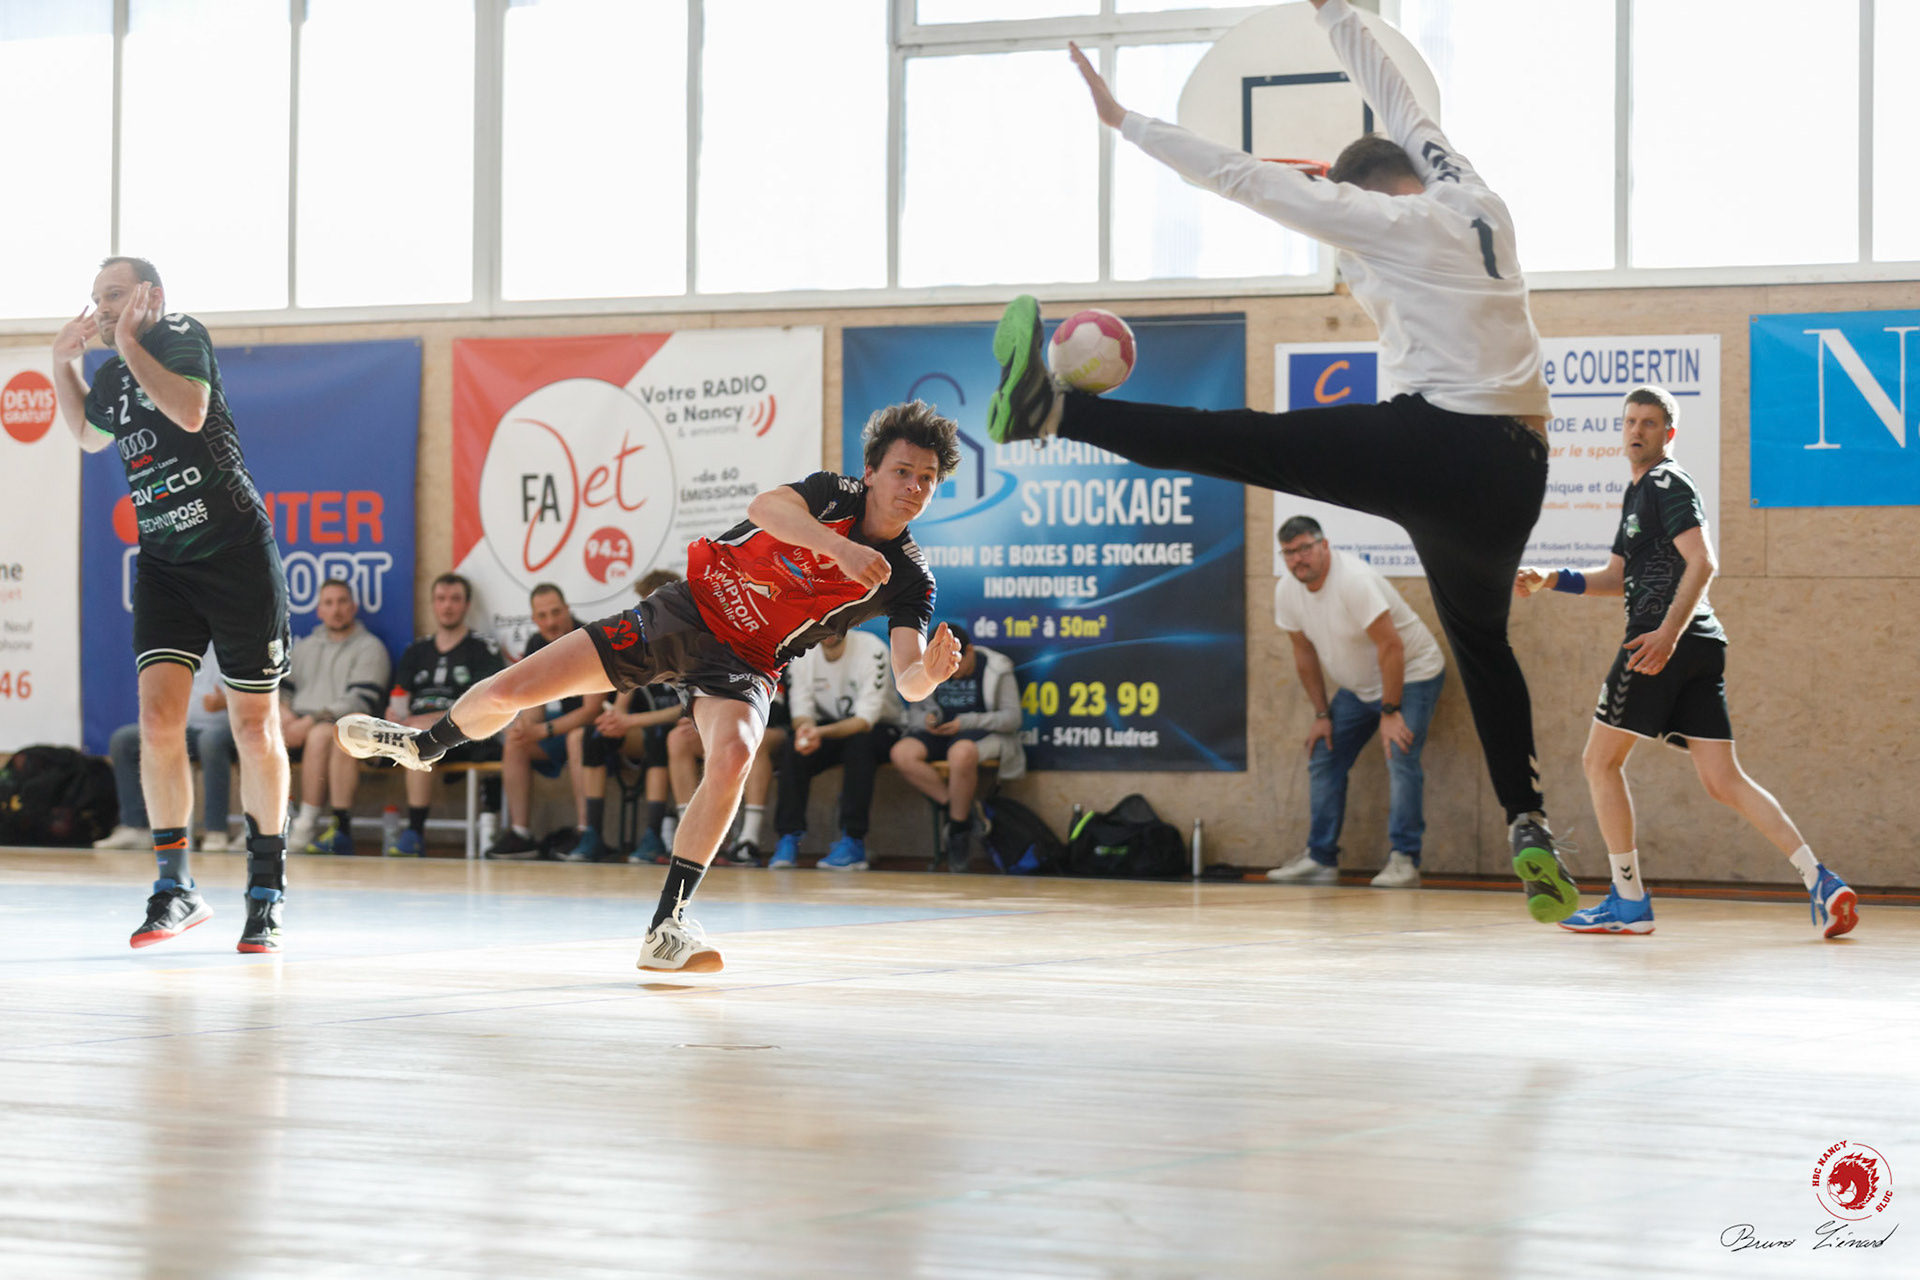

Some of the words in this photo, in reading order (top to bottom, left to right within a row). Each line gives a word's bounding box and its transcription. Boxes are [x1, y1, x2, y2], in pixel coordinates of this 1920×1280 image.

[1543, 361, 1556, 385] e
[1563, 348, 1700, 385] COUBERTIN
[640, 386, 697, 403] Votre
[702, 374, 767, 399] RADIO
[1313, 359, 1351, 404] C
[1802, 326, 1907, 449] N
[4, 389, 54, 410] DEVIS
[119, 394, 131, 425] 2
[4, 410, 53, 424] GRATUIT
[665, 406, 677, 423] à
[683, 404, 743, 422] Nancy
[1582, 417, 1607, 432] AU
[130, 454, 153, 470] Audi
[1549, 447, 1566, 458] ar
[1569, 445, 1583, 458] le
[721, 466, 739, 480] 60
[1546, 483, 1584, 496] nique
[1588, 483, 1601, 493] et
[1605, 481, 1623, 493] du
[1021, 477, 1194, 526] STOCKAGE
[174, 511, 209, 533] NANCY
[263, 491, 385, 545] TER
[587, 538, 630, 559] 94.2
[980, 545, 1004, 567] DE
[1009, 544, 1068, 567] BOXES
[1072, 544, 1097, 566] DE
[1101, 542, 1193, 566] STOCKAGE
[1574, 542, 1613, 551] Schuma
[0, 563, 23, 580] ne
[738, 576, 748, 591] LE
[983, 575, 1099, 599] INDIVIDUELS
[973, 616, 999, 638] de
[1042, 615, 1055, 638] à
[0, 670, 32, 699] 46
[1021, 681, 1060, 716] 40
[1069, 681, 1107, 716] 23
[1117, 681, 1160, 716] 99
[1020, 727, 1039, 746] al
[1052, 726, 1101, 747] 54710
[1104, 726, 1159, 747] Ludres
